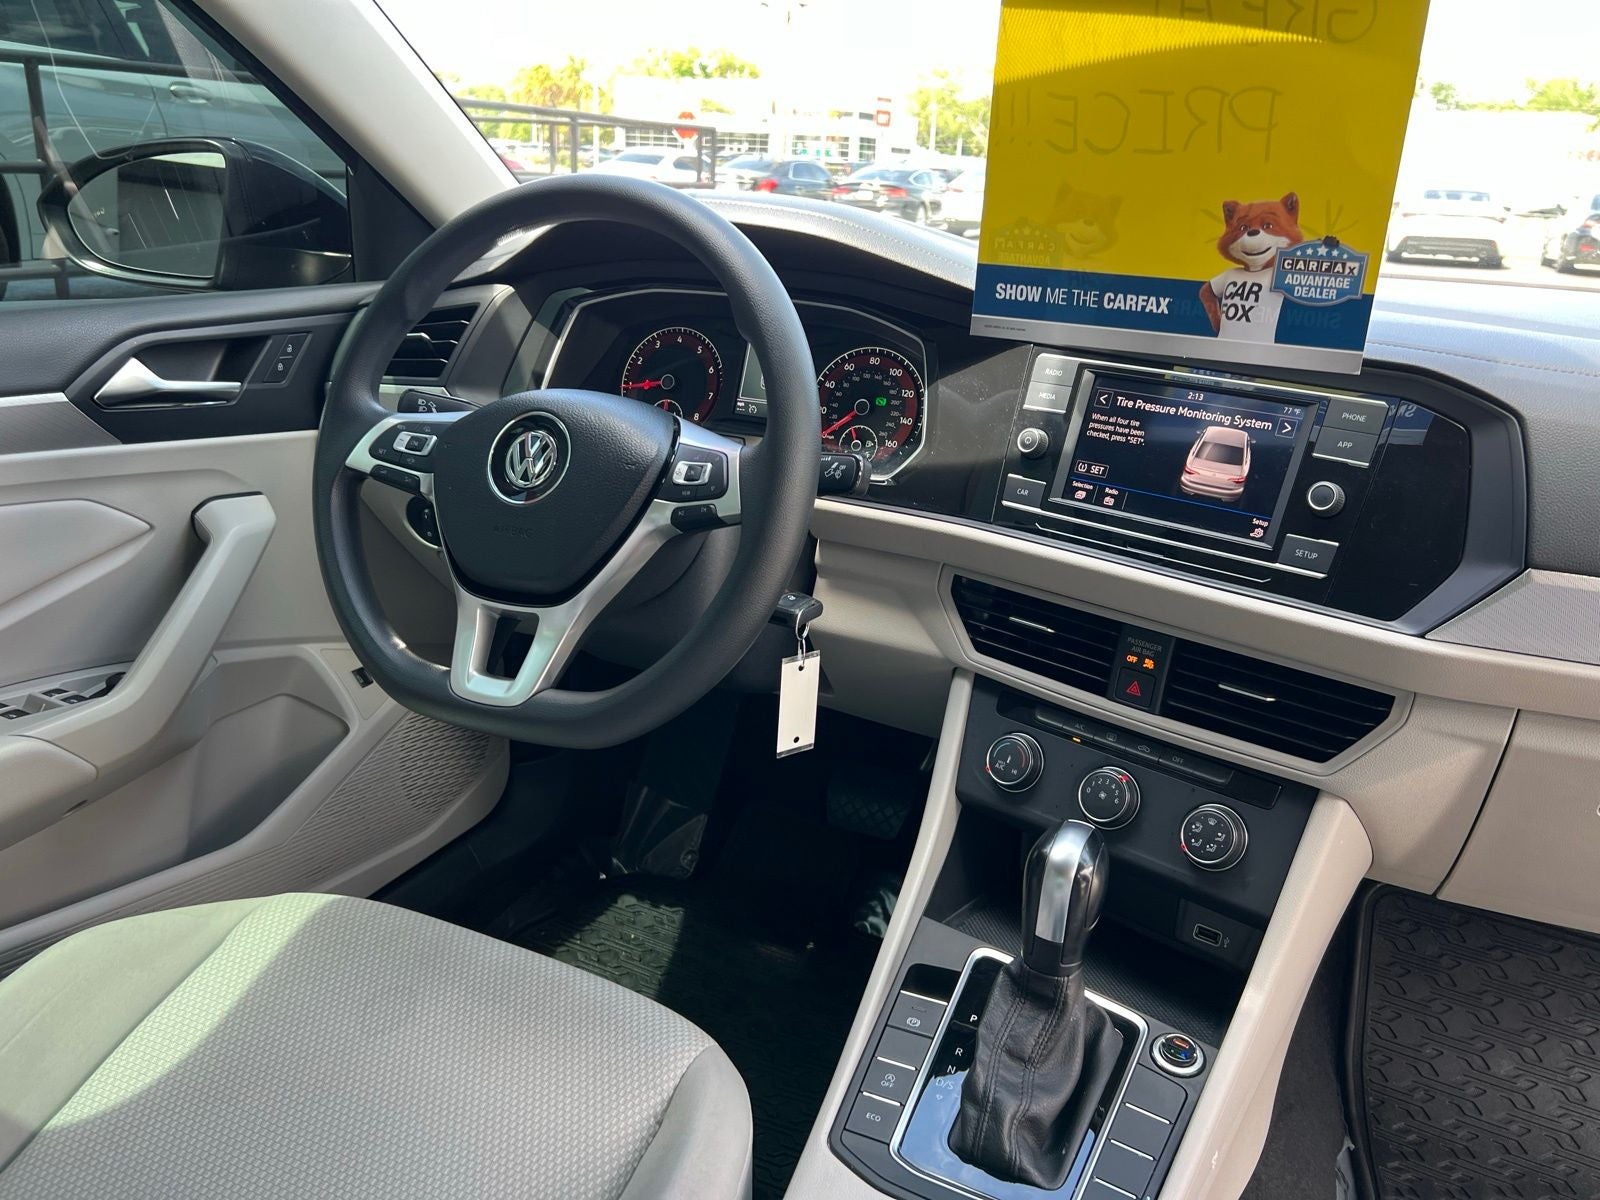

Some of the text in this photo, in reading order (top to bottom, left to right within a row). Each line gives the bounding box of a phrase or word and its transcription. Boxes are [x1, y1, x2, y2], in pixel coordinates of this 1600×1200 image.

[1281, 257, 1360, 277] CARFAX
[1284, 274, 1350, 289] ADVANTAGE
[995, 282, 1042, 303] SHOW
[1045, 287, 1068, 305] ME
[1072, 289, 1099, 308] THE
[1224, 280, 1263, 303] CAR
[1293, 286, 1336, 300] DEALER
[869, 357, 880, 365] 80
[844, 363, 855, 371] 60
[1045, 367, 1063, 377] RADIO
[889, 368, 903, 377] 100
[825, 381, 836, 389] 40
[901, 389, 914, 398] 120
[1038, 391, 1056, 400] MEDIA
[1187, 391, 1204, 401] 2:13
[1116, 396, 1273, 431] Tire Pressure Monitoring System
[1284, 406, 1293, 414] 77
[900, 417, 913, 425] 140
[1091, 412, 1109, 422] When
[1116, 417, 1129, 425] four
[1130, 419, 1140, 427] tire
[1341, 412, 1368, 423] PHONE
[1088, 422, 1145, 437] pressures have been
[1086, 429, 1110, 440] checked,
[1110, 434, 1126, 443] press
[885, 440, 898, 448] 160
[1336, 440, 1353, 449] APP
[1090, 465, 1105, 475] SET
[1072, 480, 1094, 490] Selection
[1016, 488, 1029, 497] CAR
[1104, 487, 1119, 495] Radio
[1252, 517, 1269, 528] Setup
[1295, 549, 1318, 560] SETUP
[1126, 654, 1139, 664] OFF
[1172, 755, 1185, 764] OFF
[969, 1014, 978, 1022] P
[955, 1047, 963, 1056] R
[947, 1065, 956, 1074] N
[880, 1080, 895, 1088] OFF
[865, 1111, 881, 1122] ECO
